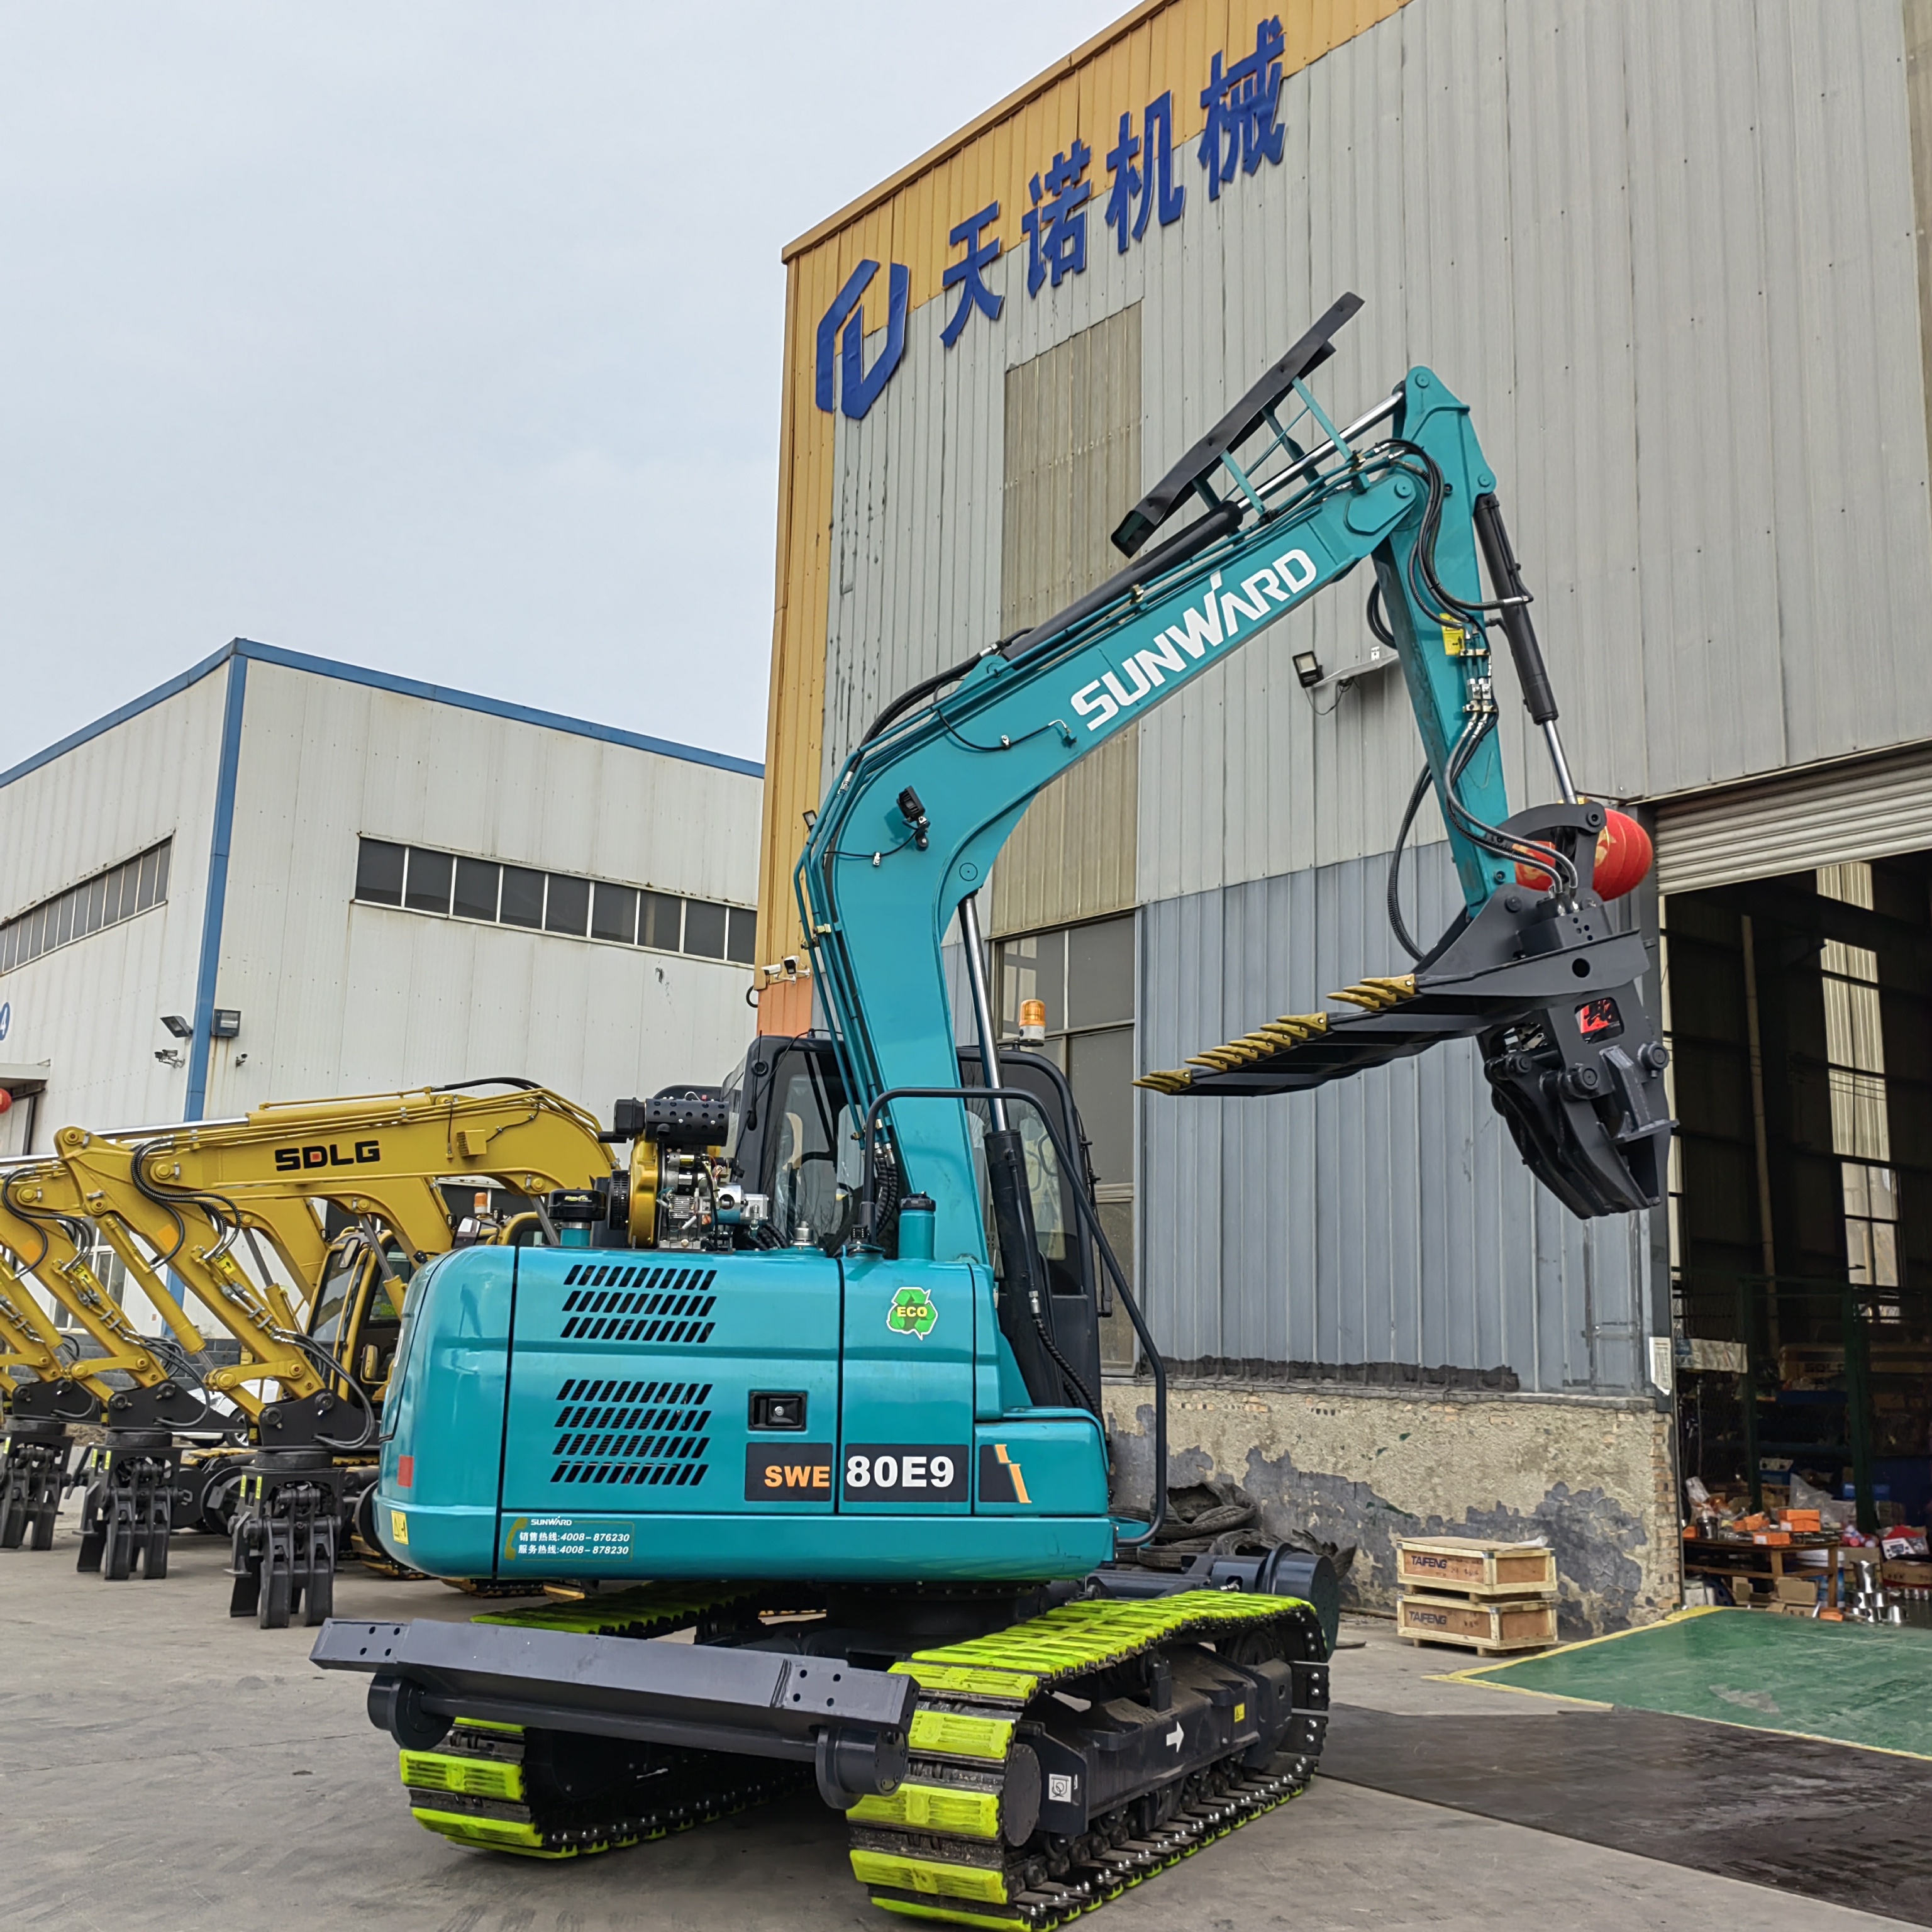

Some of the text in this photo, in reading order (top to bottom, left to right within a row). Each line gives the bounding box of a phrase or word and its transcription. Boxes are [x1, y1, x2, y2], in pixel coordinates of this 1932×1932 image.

[940, 15, 1287, 348] 天诺机械
[1070, 549, 1317, 731] SUNWARD
[275, 1140, 380, 1172] SDLG
[897, 1306, 928, 1318] ECO
[764, 1456, 955, 1487] SWE 80E9
[531, 1516, 572, 1526] SUNWARD
[1411, 1555, 1447, 1569] TAIFENG
[1409, 1611, 1447, 1625] TAIFENG
